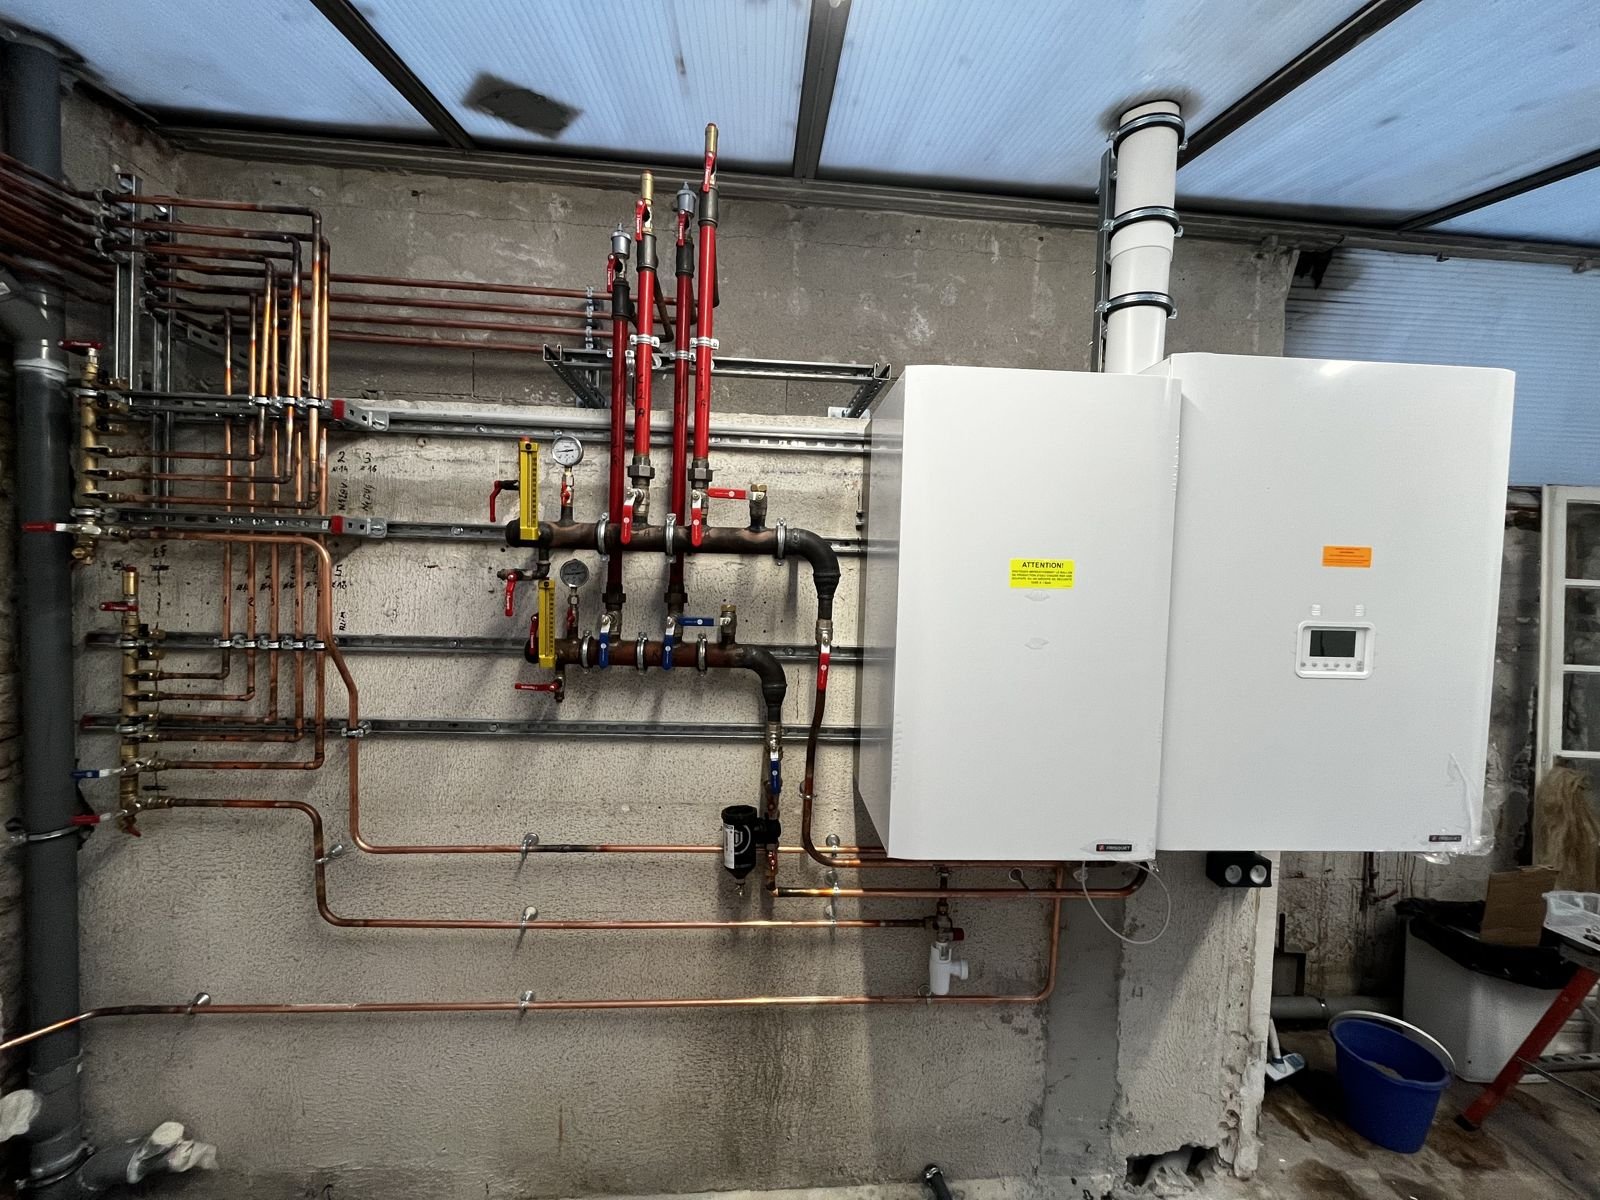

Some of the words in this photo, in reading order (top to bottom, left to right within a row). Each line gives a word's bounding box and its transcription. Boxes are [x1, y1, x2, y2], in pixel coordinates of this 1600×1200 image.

[337, 451, 346, 463] 2
[363, 451, 372, 464] 3
[334, 563, 343, 577] 5
[1022, 561, 1064, 569] ATTENTION!
